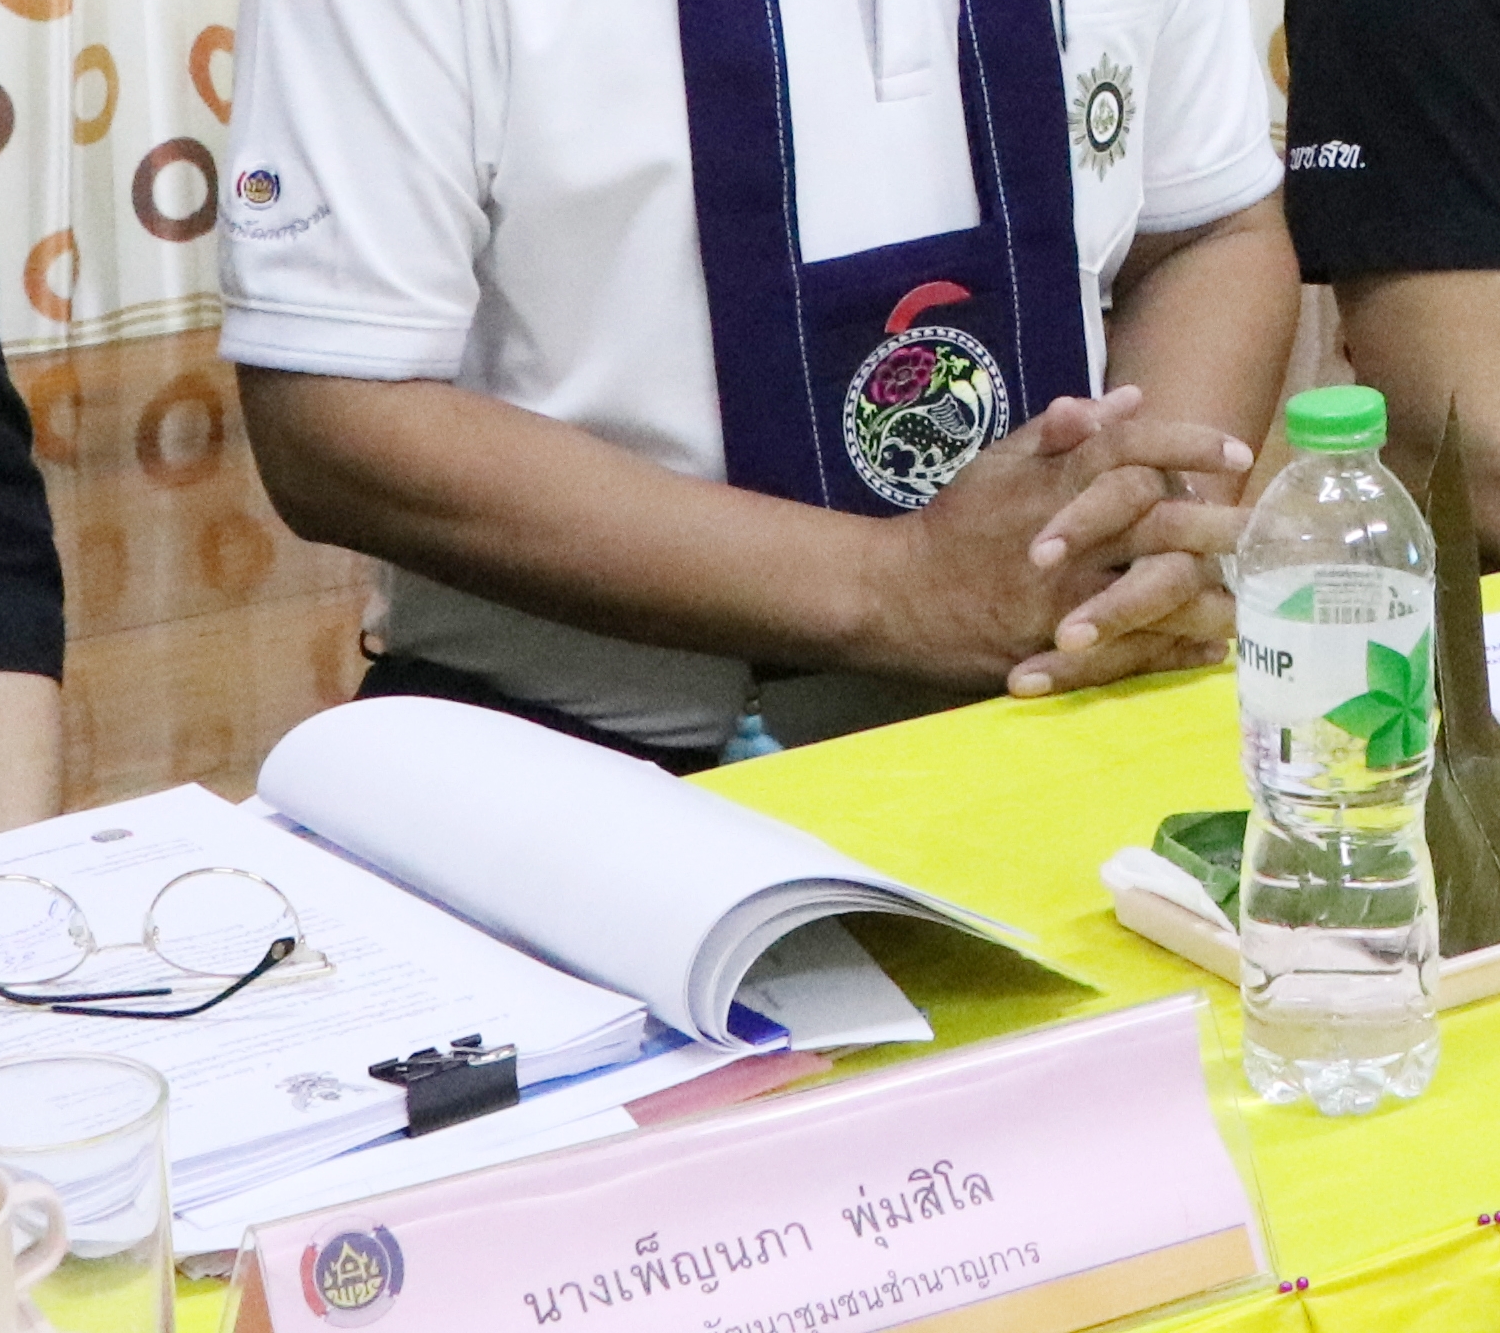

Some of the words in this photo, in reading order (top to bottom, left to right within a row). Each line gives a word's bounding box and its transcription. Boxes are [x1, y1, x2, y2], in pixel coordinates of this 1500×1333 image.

[522, 1219, 814, 1328] นางเพ็ญนภา
[841, 1158, 996, 1250] พุ่มสิโล
